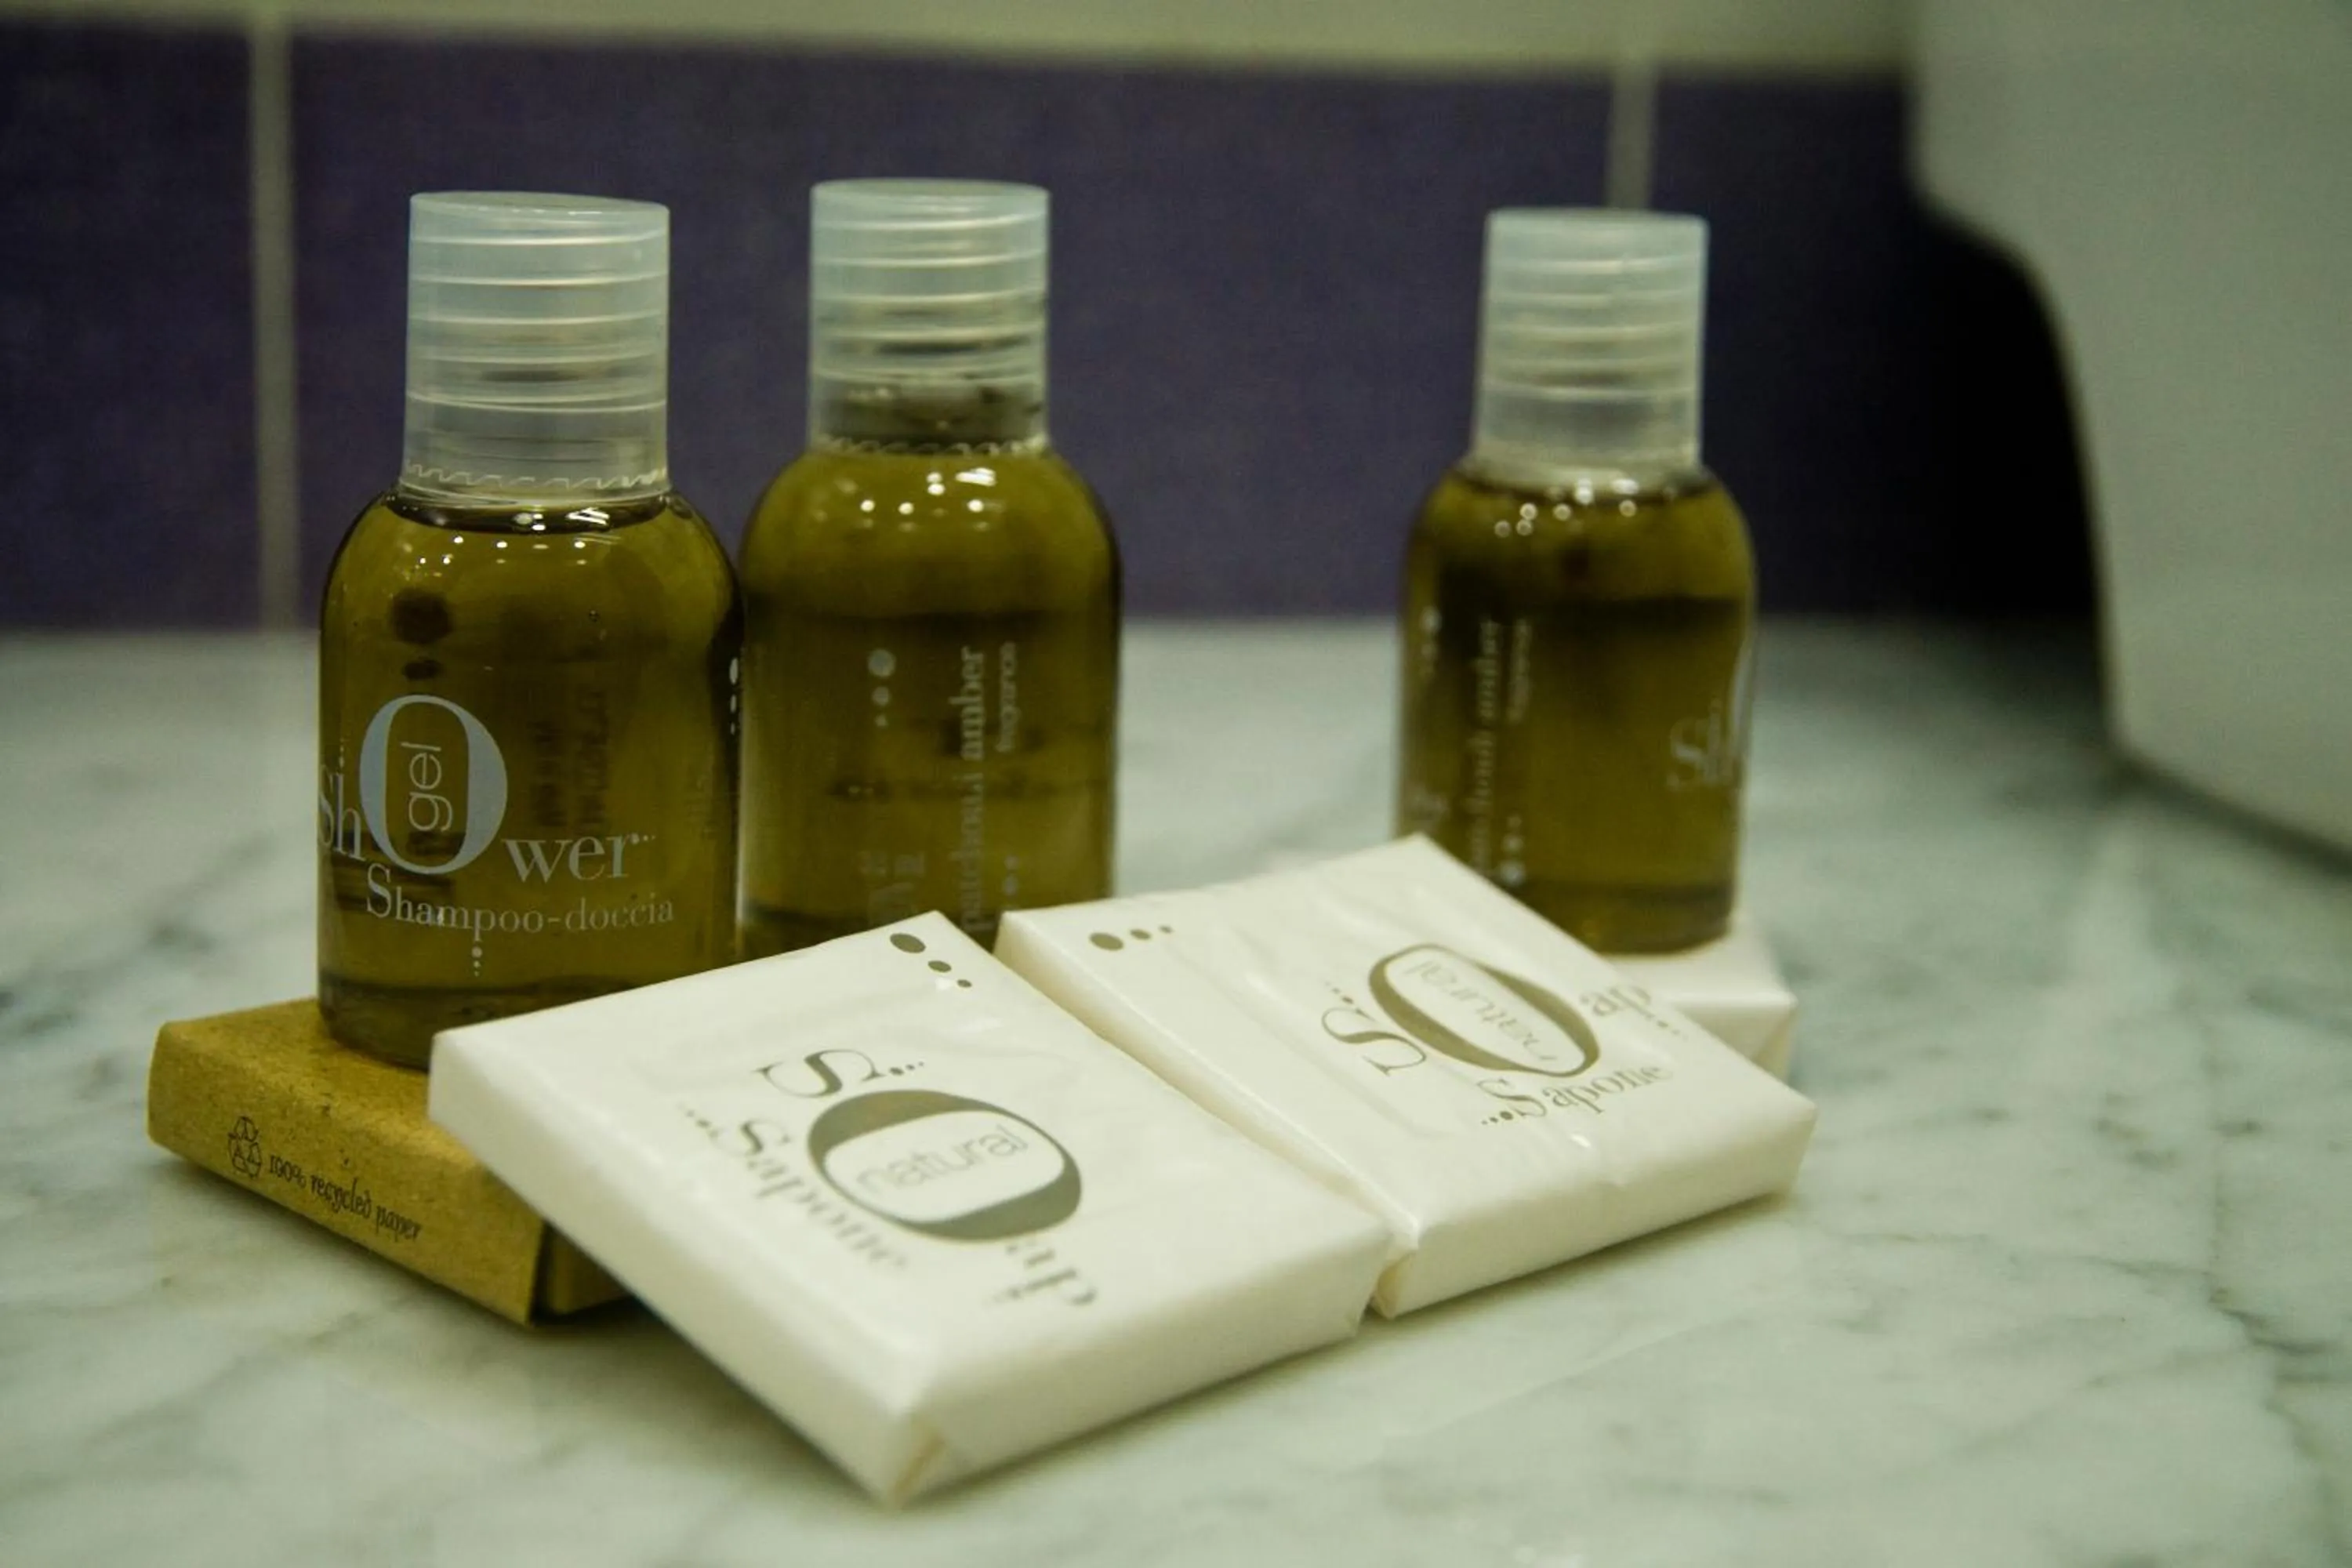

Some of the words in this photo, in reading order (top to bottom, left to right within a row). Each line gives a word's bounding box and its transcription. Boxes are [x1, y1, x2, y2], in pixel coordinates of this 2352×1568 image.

[949, 645, 985, 761] amber
[401, 742, 452, 832] gel
[366, 864, 674, 941] Shampoo-doccia
[1478, 1066, 1675, 1118] Sapone
[270, 1155, 307, 1189] 100%
[310, 1175, 372, 1218] recycled
[855, 1124, 1029, 1195] natural
